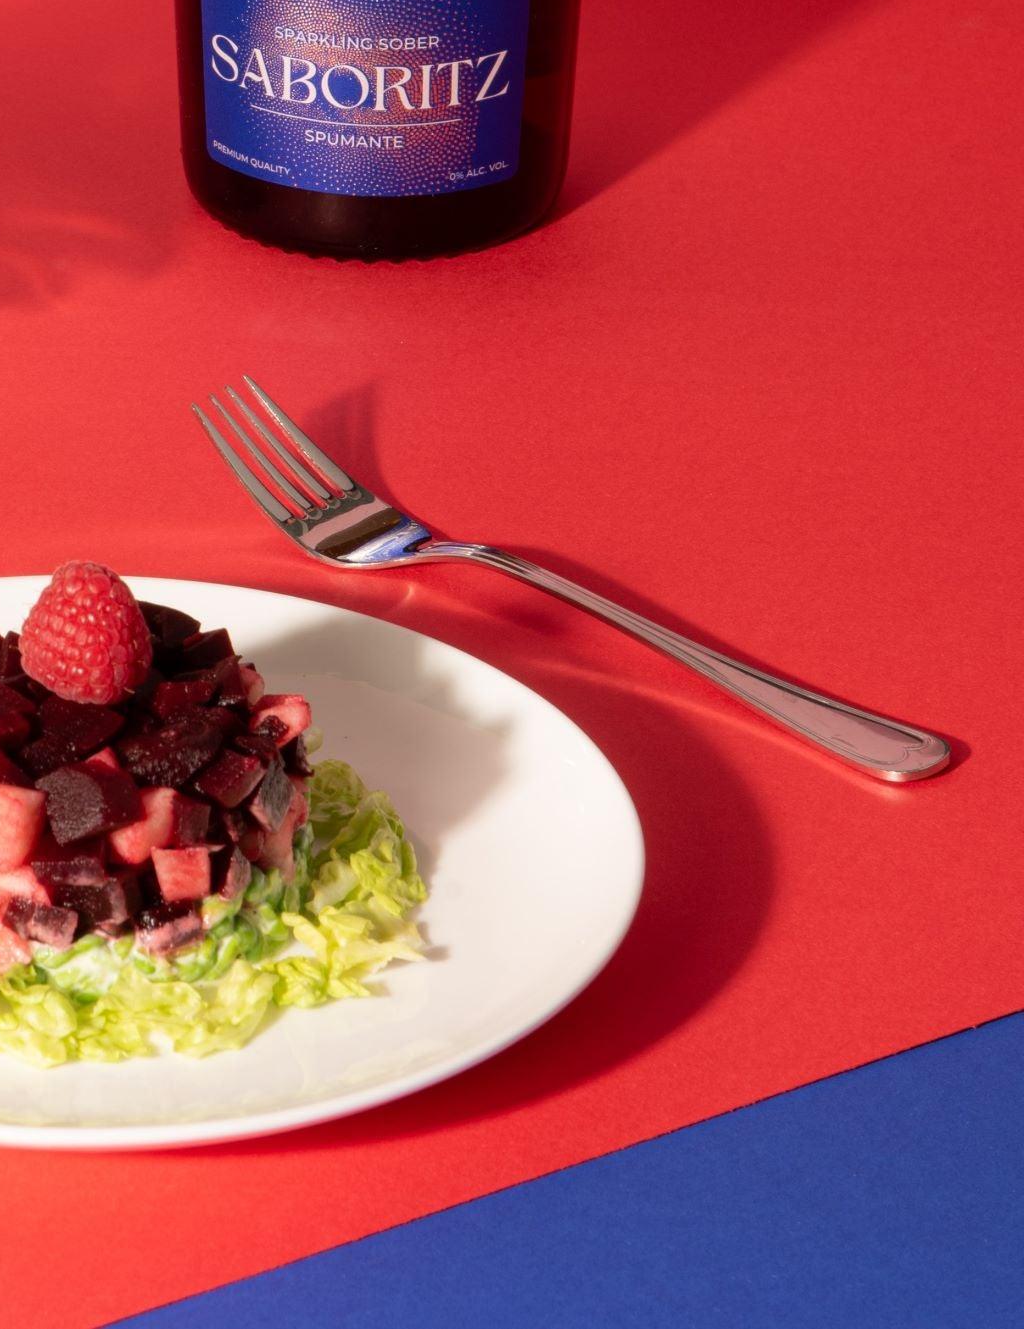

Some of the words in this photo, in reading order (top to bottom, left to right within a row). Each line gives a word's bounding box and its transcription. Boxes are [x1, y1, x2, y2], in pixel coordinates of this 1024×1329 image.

[274, 26, 373, 50] SPARKLING
[378, 35, 440, 51] SOBER
[211, 33, 510, 111] SABORITZ
[304, 129, 404, 149] SPUMANTE
[213, 140, 249, 164] PREMIUM
[250, 158, 291, 175] QUALITY
[449, 172, 465, 181] 0%
